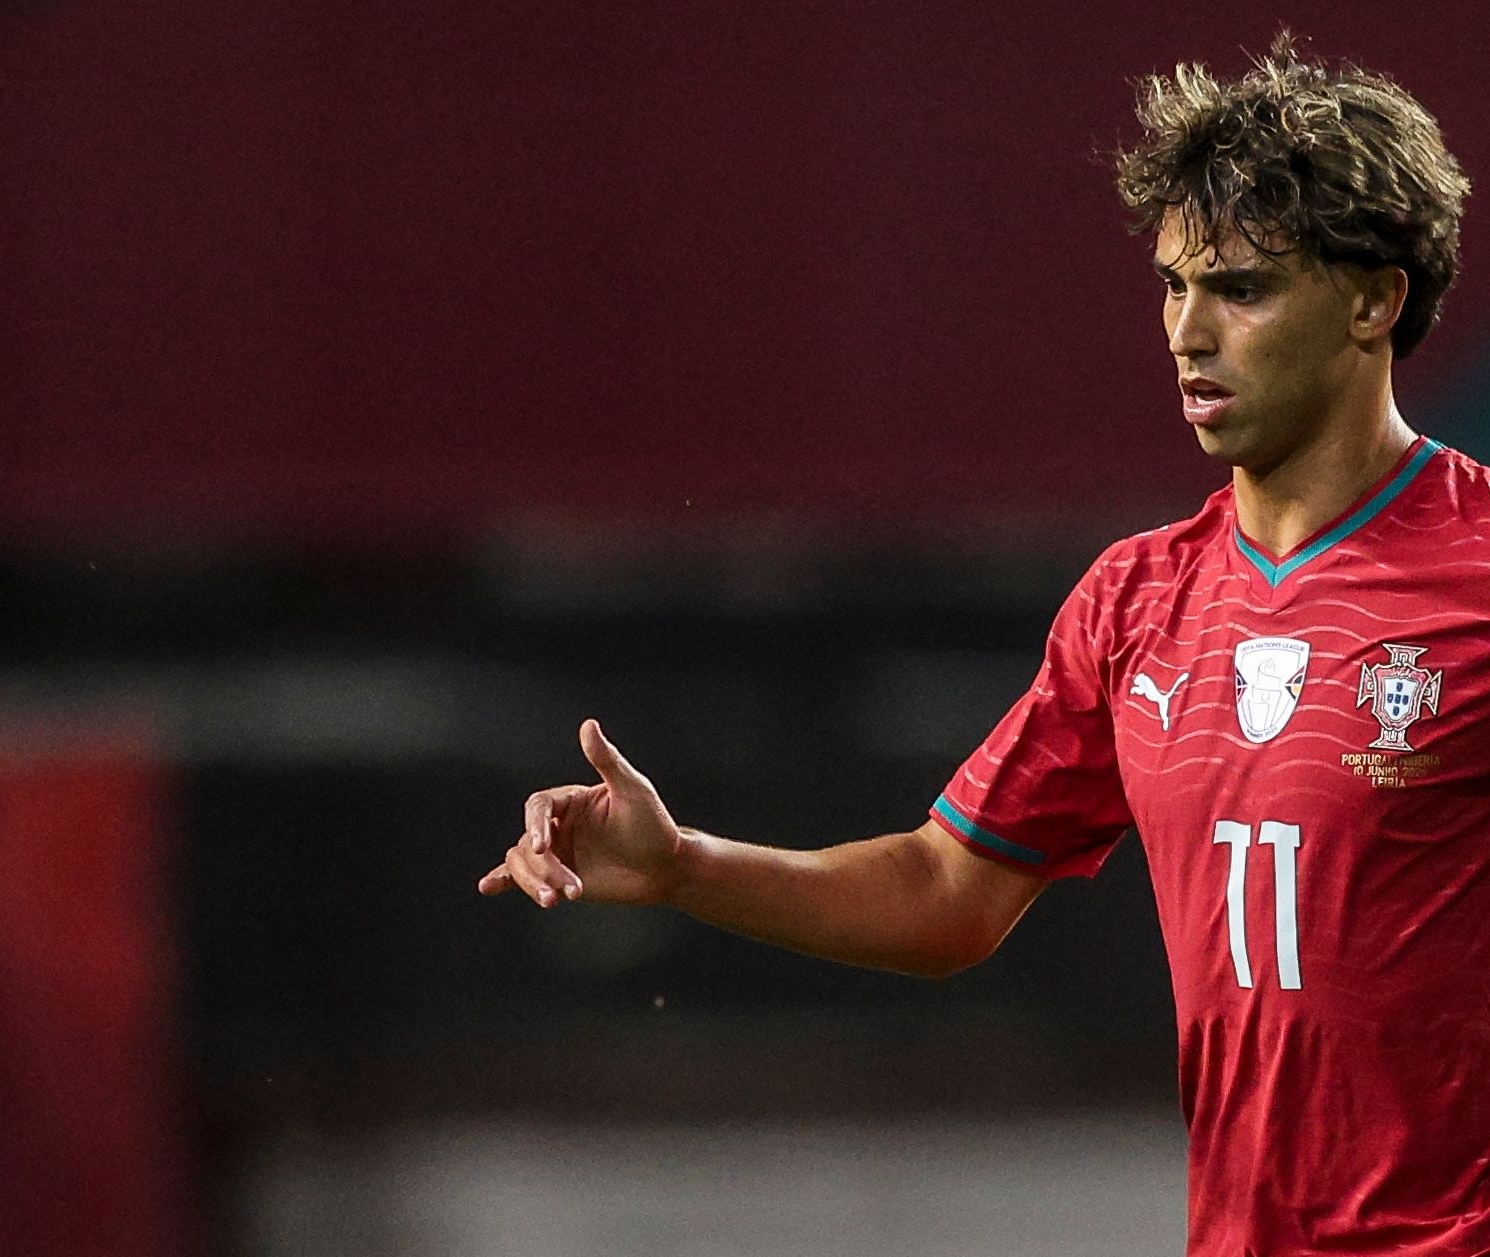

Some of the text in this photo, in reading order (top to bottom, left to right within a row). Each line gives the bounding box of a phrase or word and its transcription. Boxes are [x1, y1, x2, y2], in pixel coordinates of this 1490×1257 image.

[1353, 765, 1364, 776] 10
[1366, 765, 1398, 777] JUNHO
[1371, 776, 1406, 788] LEIRIA
[1212, 819, 1303, 990] 11
